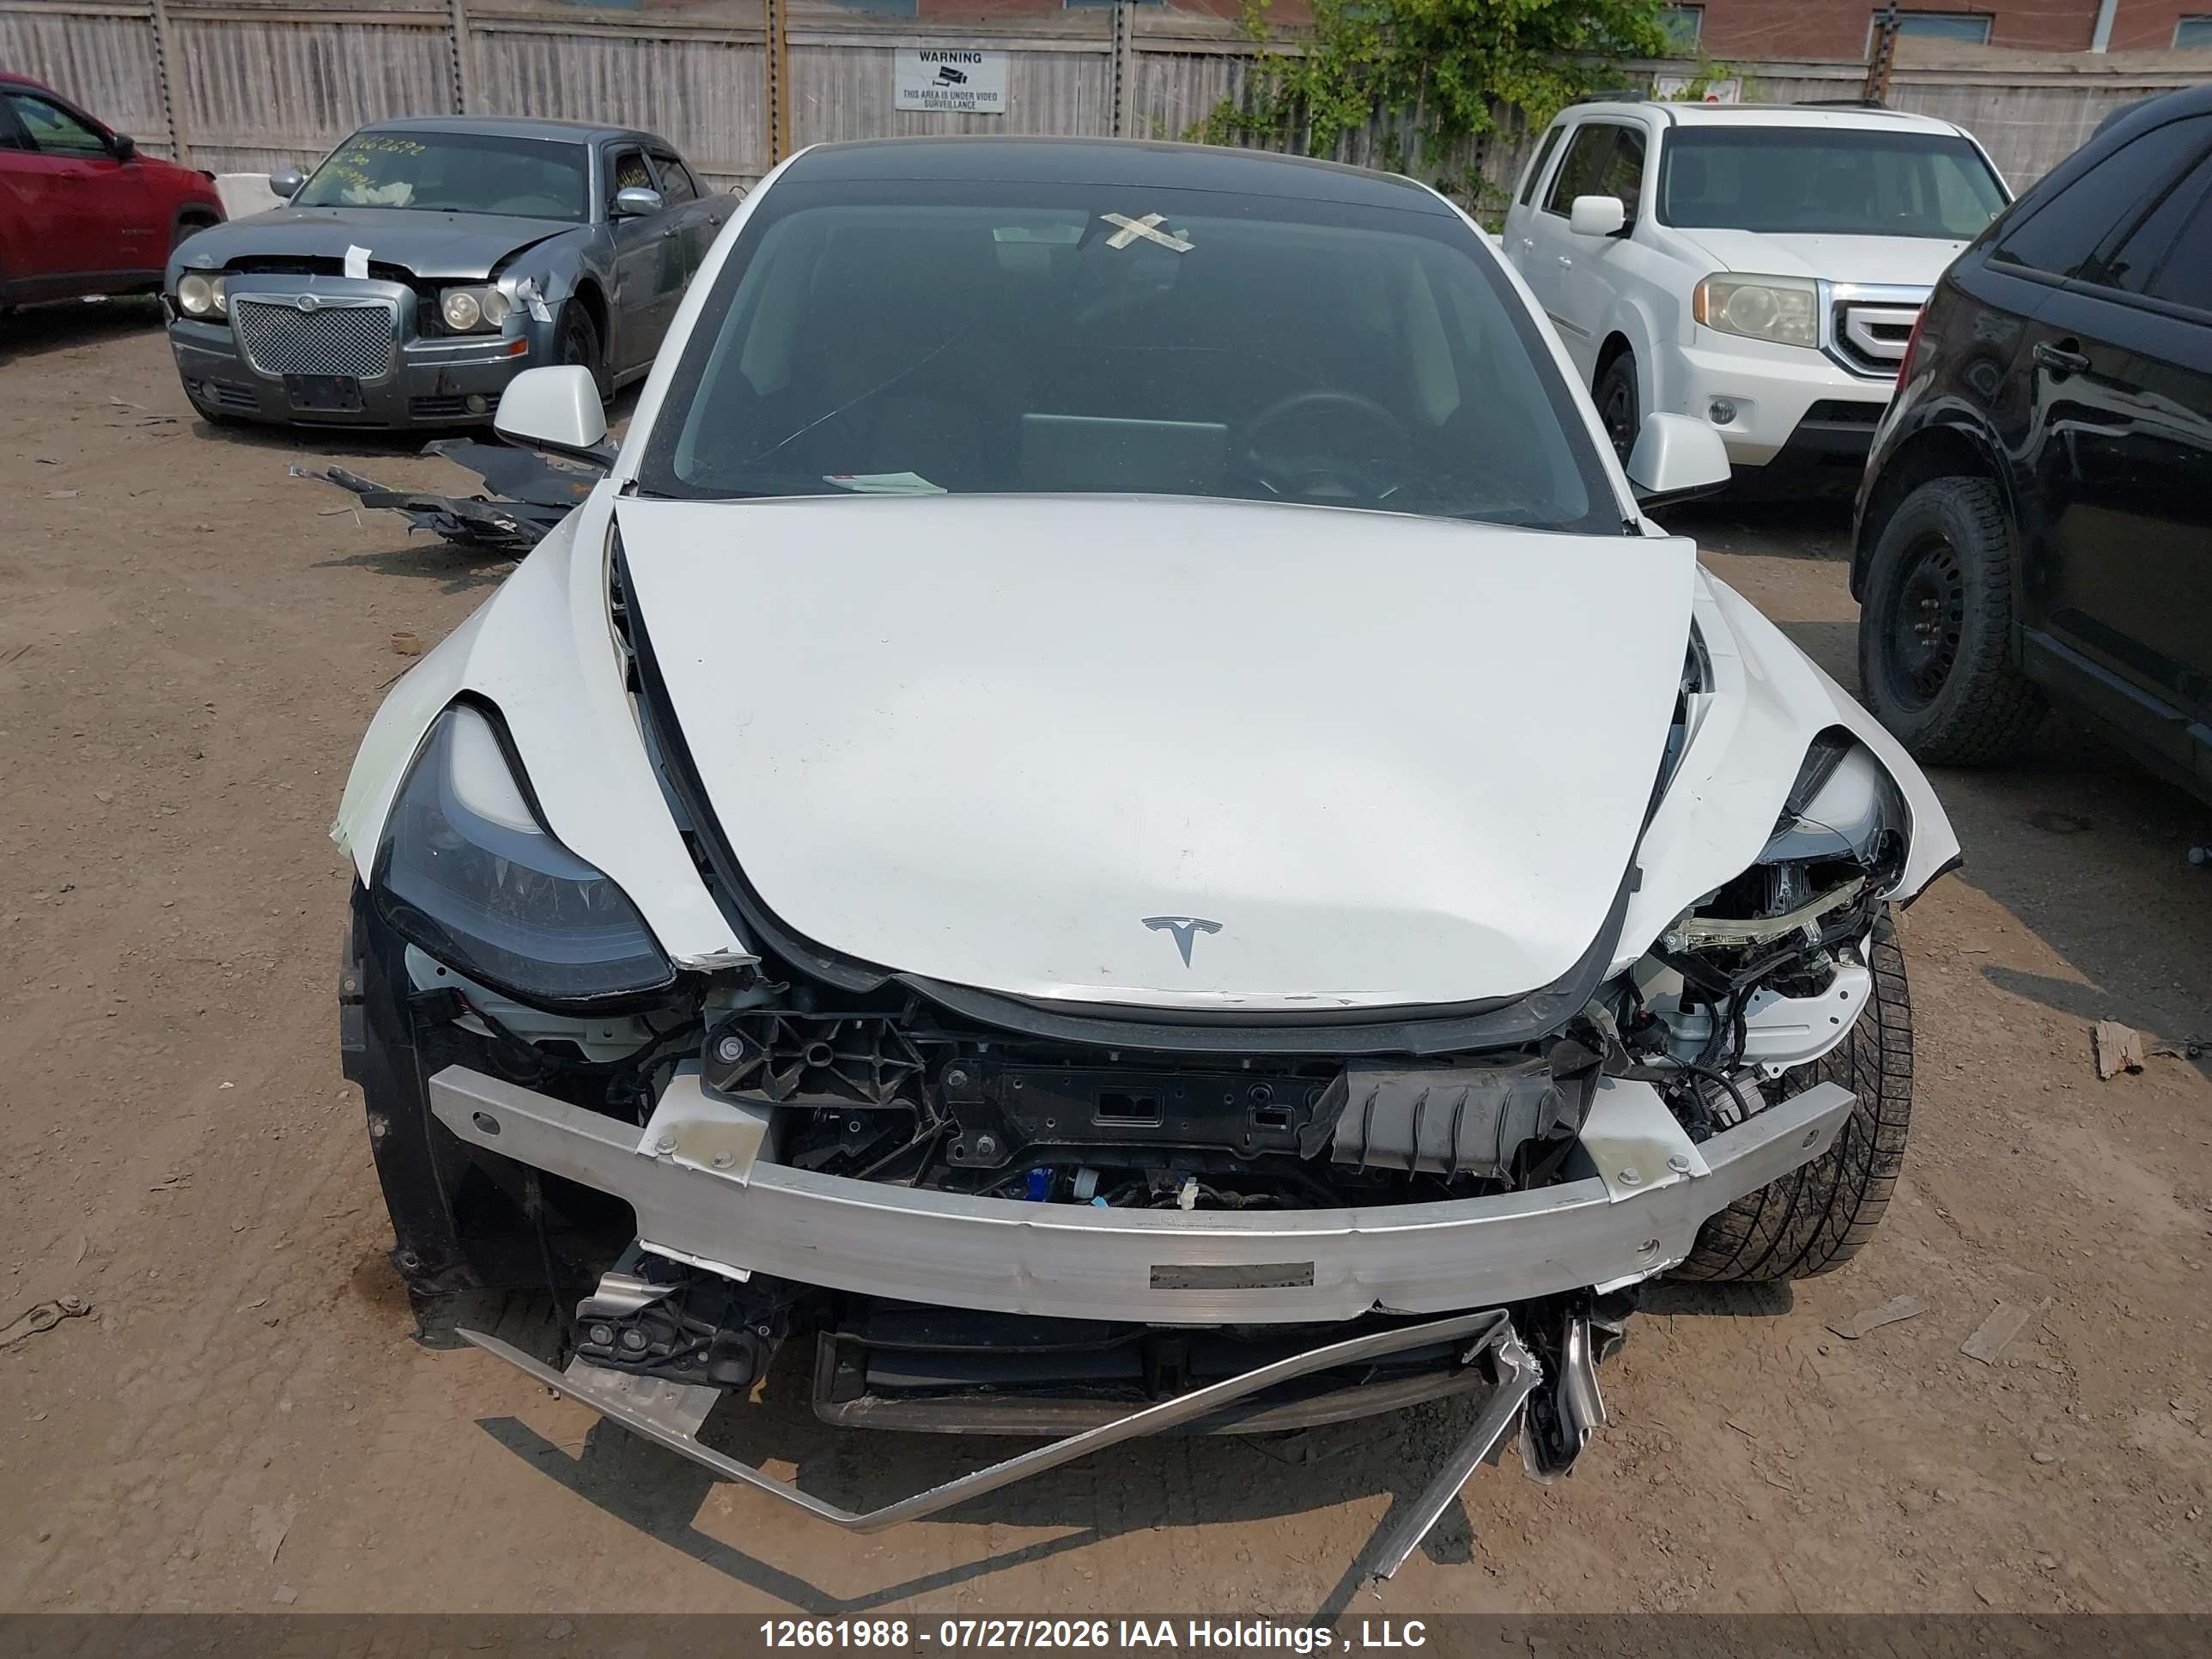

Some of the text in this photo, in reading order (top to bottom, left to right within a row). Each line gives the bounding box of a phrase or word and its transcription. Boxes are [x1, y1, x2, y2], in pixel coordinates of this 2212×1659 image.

[920, 51, 982, 64] WARNING
[903, 89, 998, 101] THIS AREA IS UNDER VIDEO
[924, 100, 976, 110] SURVEILLANCE
